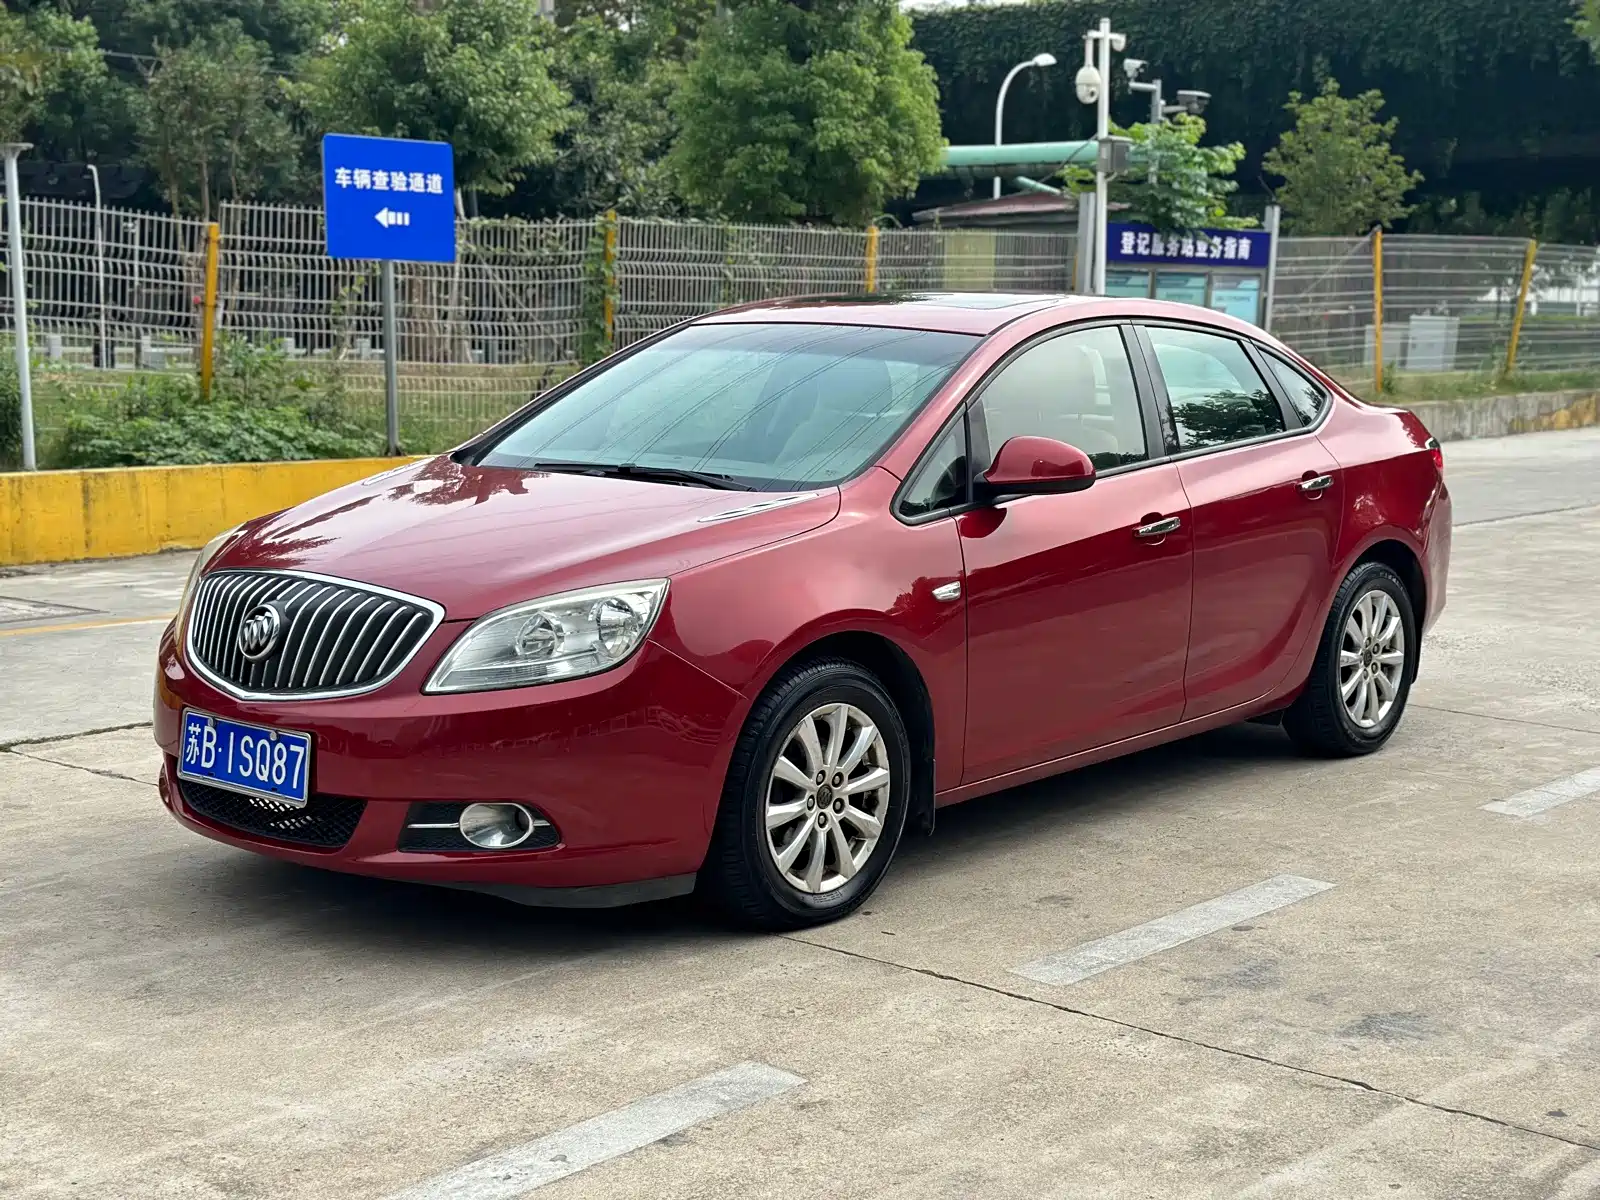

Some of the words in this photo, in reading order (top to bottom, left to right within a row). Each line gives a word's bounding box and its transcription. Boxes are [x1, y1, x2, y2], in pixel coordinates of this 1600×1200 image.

[334, 167, 443, 194] 车辆查验通道
